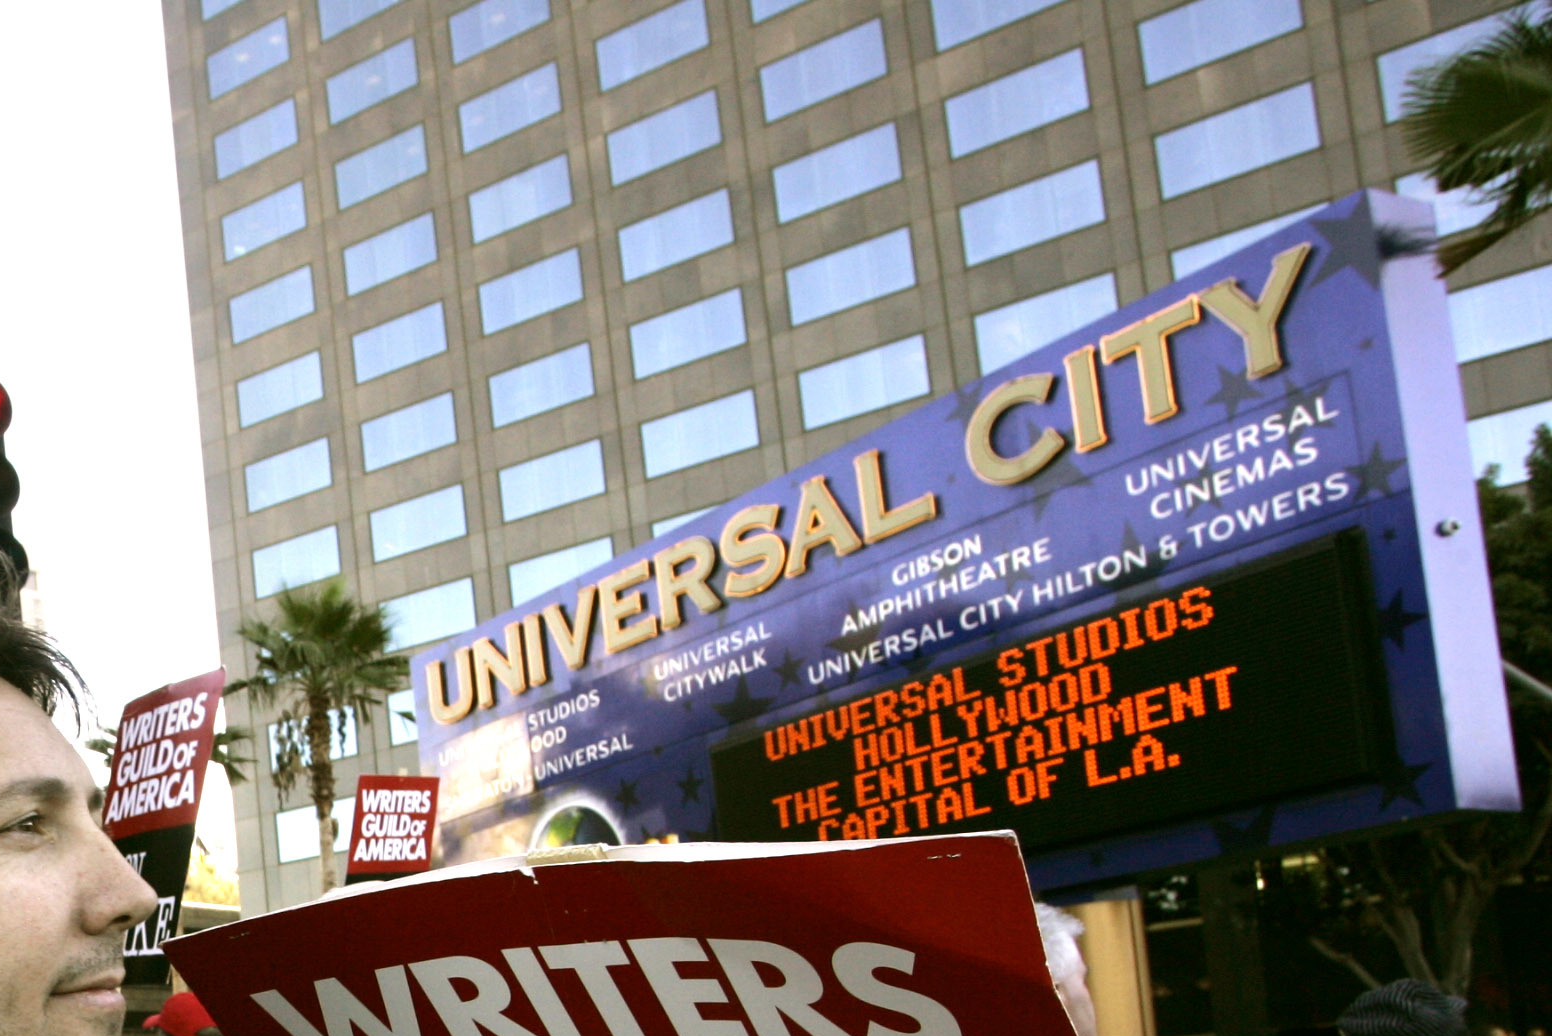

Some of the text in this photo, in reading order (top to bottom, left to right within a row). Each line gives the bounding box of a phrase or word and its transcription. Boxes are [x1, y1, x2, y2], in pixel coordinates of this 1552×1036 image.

[1124, 396, 1340, 497] UNIVERSAL
[424, 241, 1312, 727] UNIVERSAL CITY
[1149, 436, 1319, 521] CINEMAS
[807, 471, 1350, 685] UNIVERSAL CITY HILTON & TOWERS
[840, 536, 1052, 636] AMPHITHEATRE
[891, 532, 983, 587] GIBSON
[653, 621, 773, 682] UNIVERSAL
[663, 647, 768, 703] CITYWALK
[764, 585, 1215, 762] UNIVERSAL STUDIOS
[121, 692, 208, 752] WRITERS
[528, 689, 601, 732] STUDIOS
[854, 661, 1112, 771] HOLLYWOOD
[116, 739, 198, 788] GUILD OF
[534, 732, 634, 781] UNIVERSAL
[772, 666, 1237, 829] THE ENTERTAINMENT
[105, 769, 195, 825] AMERICA
[362, 789, 431, 813] WRITERS
[818, 734, 1181, 841] CAPITAL OF L.A.
[353, 838, 427, 862] AMERICA
[361, 814, 427, 838] GUILD OF
